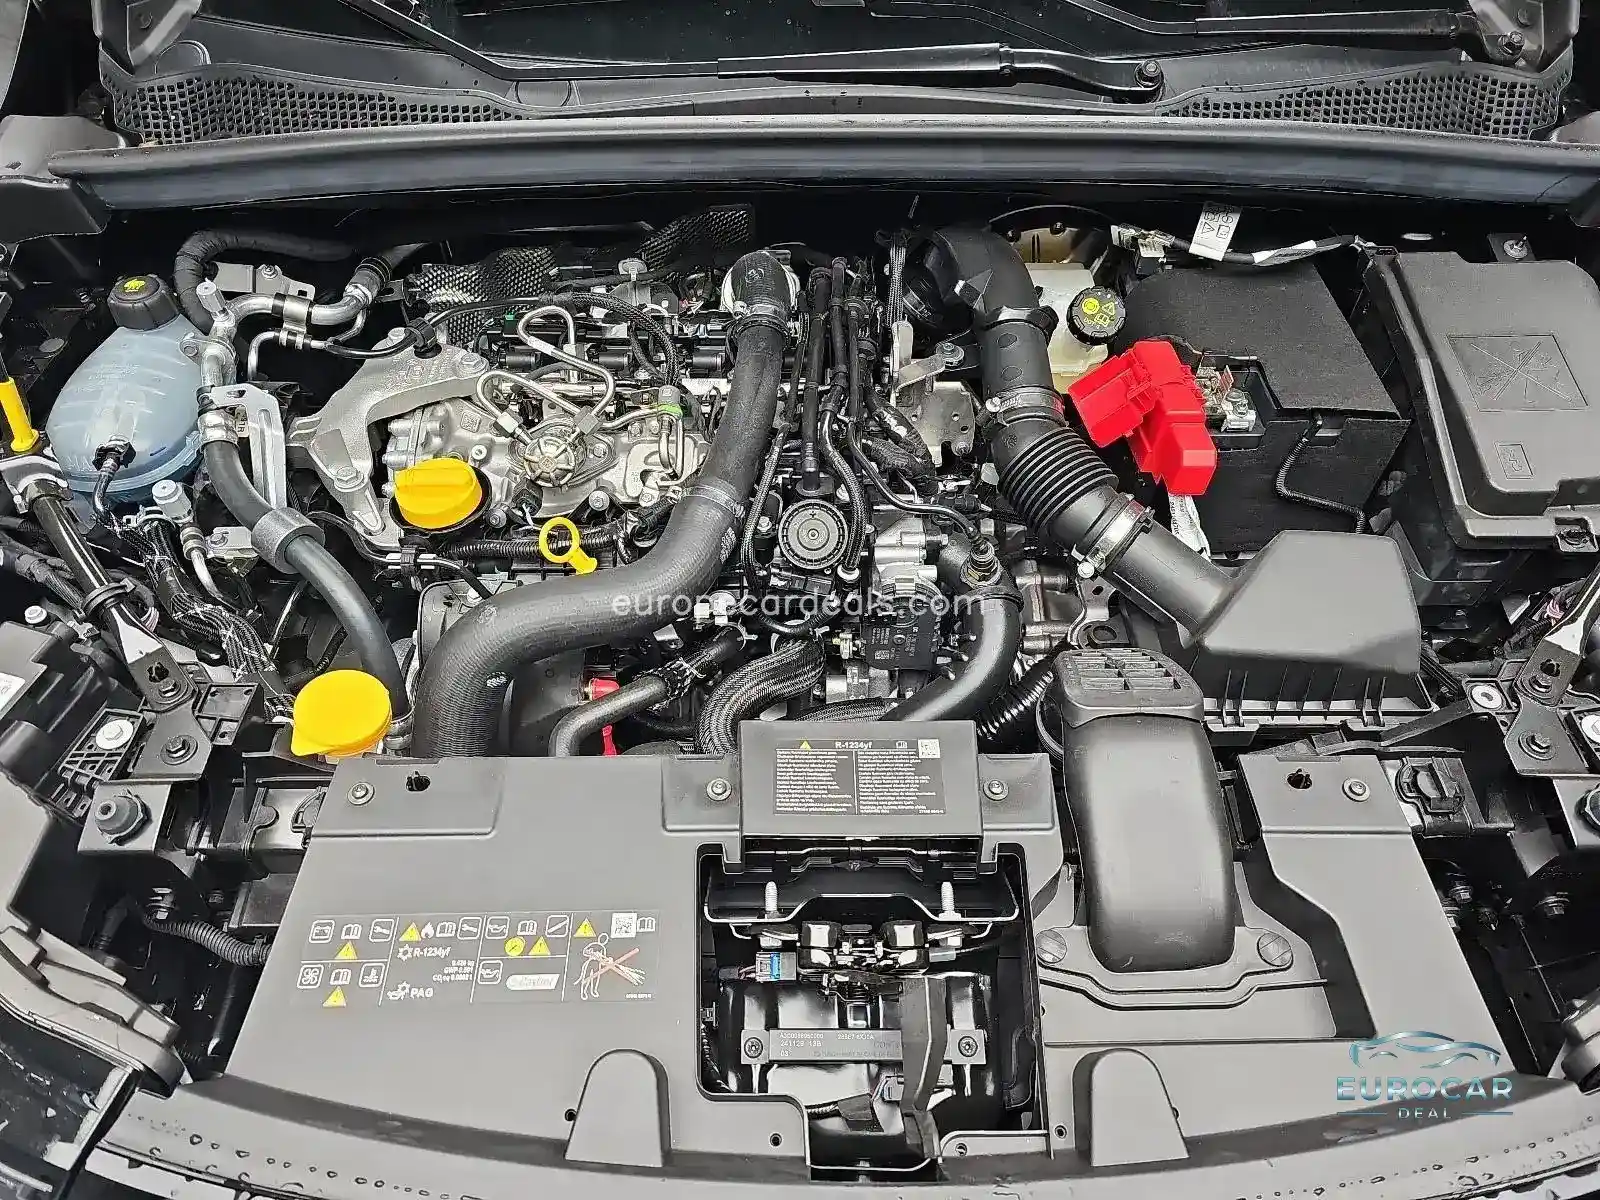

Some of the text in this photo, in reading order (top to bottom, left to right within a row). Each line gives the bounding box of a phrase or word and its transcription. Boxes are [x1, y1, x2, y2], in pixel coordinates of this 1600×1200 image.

[835, 740, 873, 750] R-1234yf
[413, 947, 452, 959] R-1234yf
[410, 987, 434, 1000] PAG
